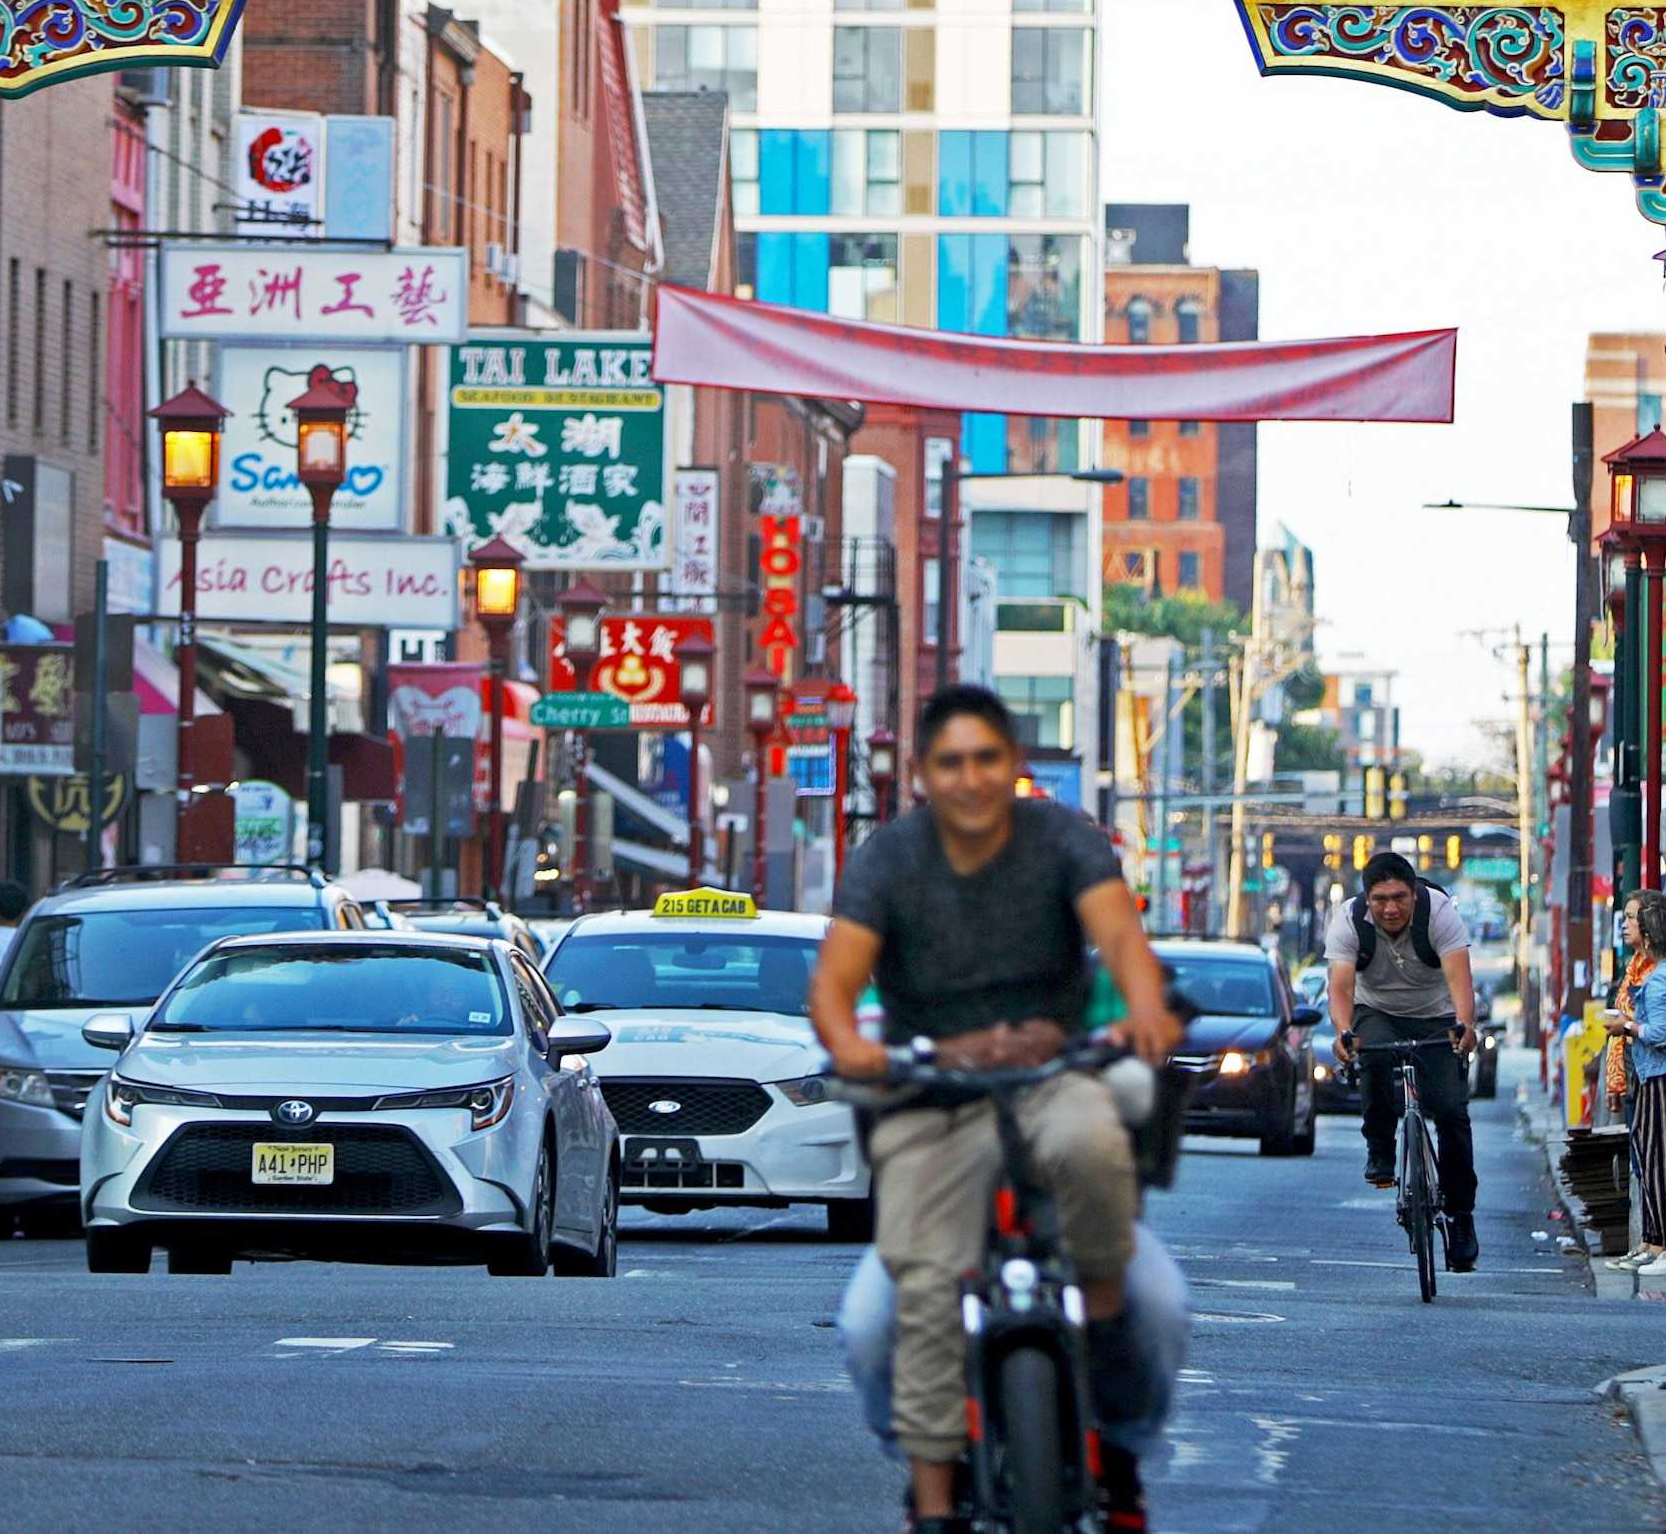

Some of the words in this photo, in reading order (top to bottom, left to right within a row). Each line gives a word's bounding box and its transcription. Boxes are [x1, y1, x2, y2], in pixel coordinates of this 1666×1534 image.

[459, 346, 526, 385] TAI
[544, 347, 658, 387] LAKE
[386, 569, 449, 596] Inc.
[533, 702, 601, 727] Cherry
[662, 899, 683, 913] 215
[686, 900, 710, 914] GET
[711, 900, 720, 914] A
[721, 901, 746, 915] CAB
